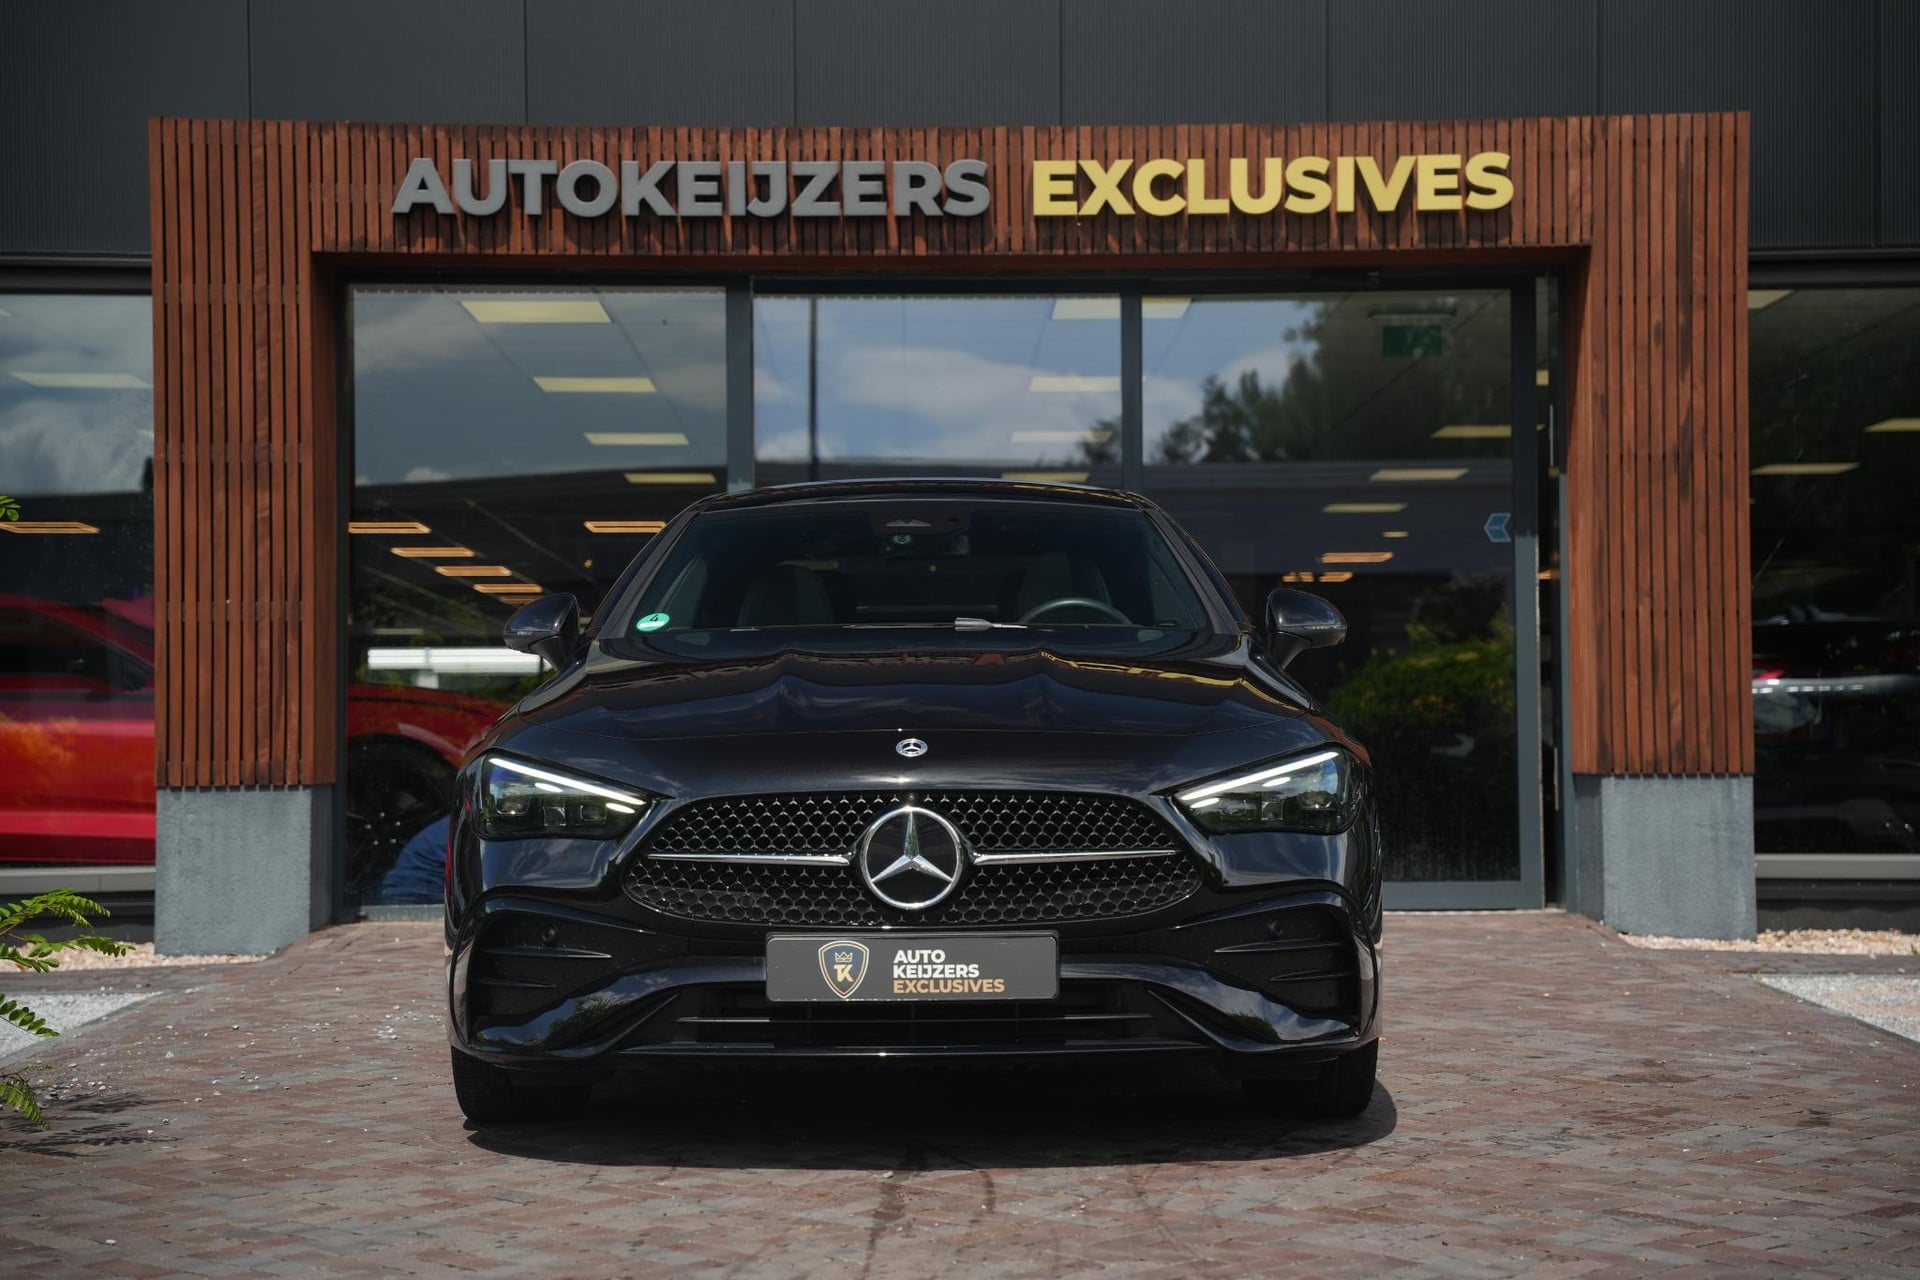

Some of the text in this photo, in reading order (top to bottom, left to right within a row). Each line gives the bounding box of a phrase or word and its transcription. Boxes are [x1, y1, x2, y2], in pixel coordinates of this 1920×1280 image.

[391, 151, 1515, 218] AUTOKEIJZERS EXCLUSIVES
[893, 949, 946, 964] AUTO
[893, 964, 980, 979] KEIJZERS
[893, 979, 1005, 994] EXCLUSIVES
